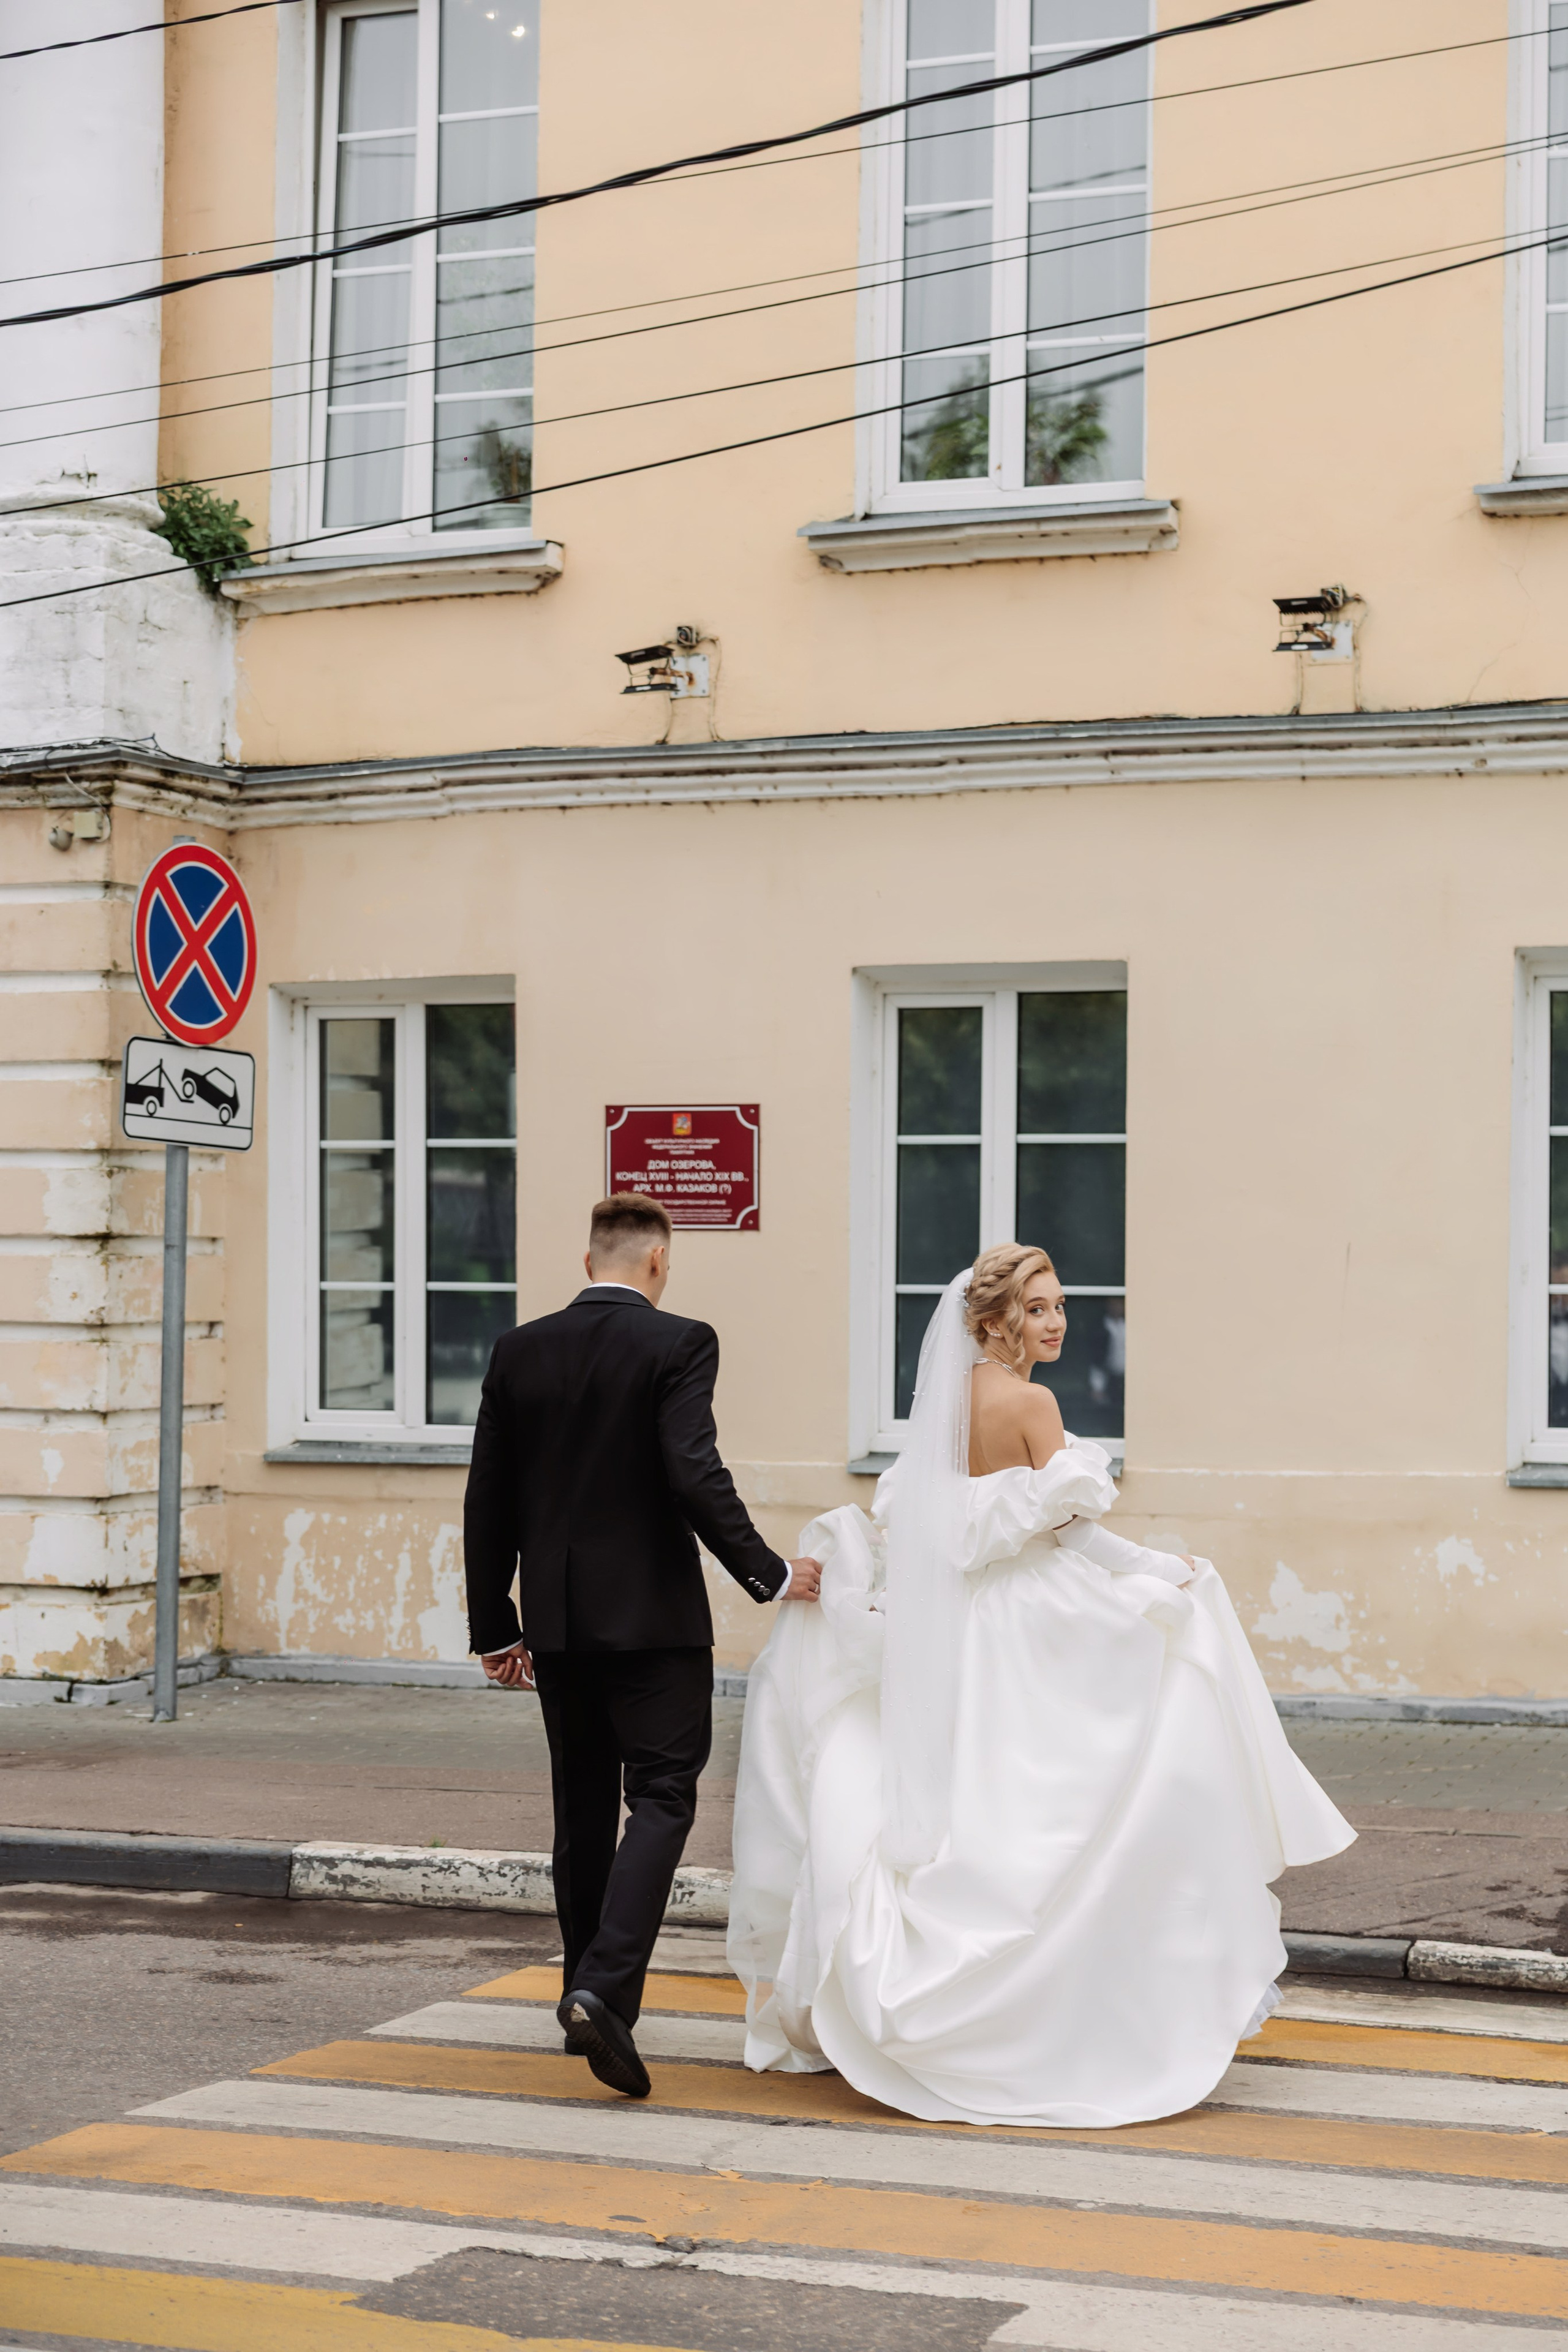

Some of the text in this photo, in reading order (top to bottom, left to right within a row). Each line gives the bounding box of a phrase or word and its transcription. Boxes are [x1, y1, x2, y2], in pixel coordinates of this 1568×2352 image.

[647, 1160, 716, 1170] ДОМ ОЗЕРОВА,
[616, 1171, 647, 1182] КОНЕЦ
[649, 1172, 669, 1180] XVIII
[675, 1172, 713, 1181] НАЧАЛО
[714, 1172, 729, 1181] XIX
[633, 1183, 732, 1194] АРХ. М.Ф. КАЗАКОВ (?)
